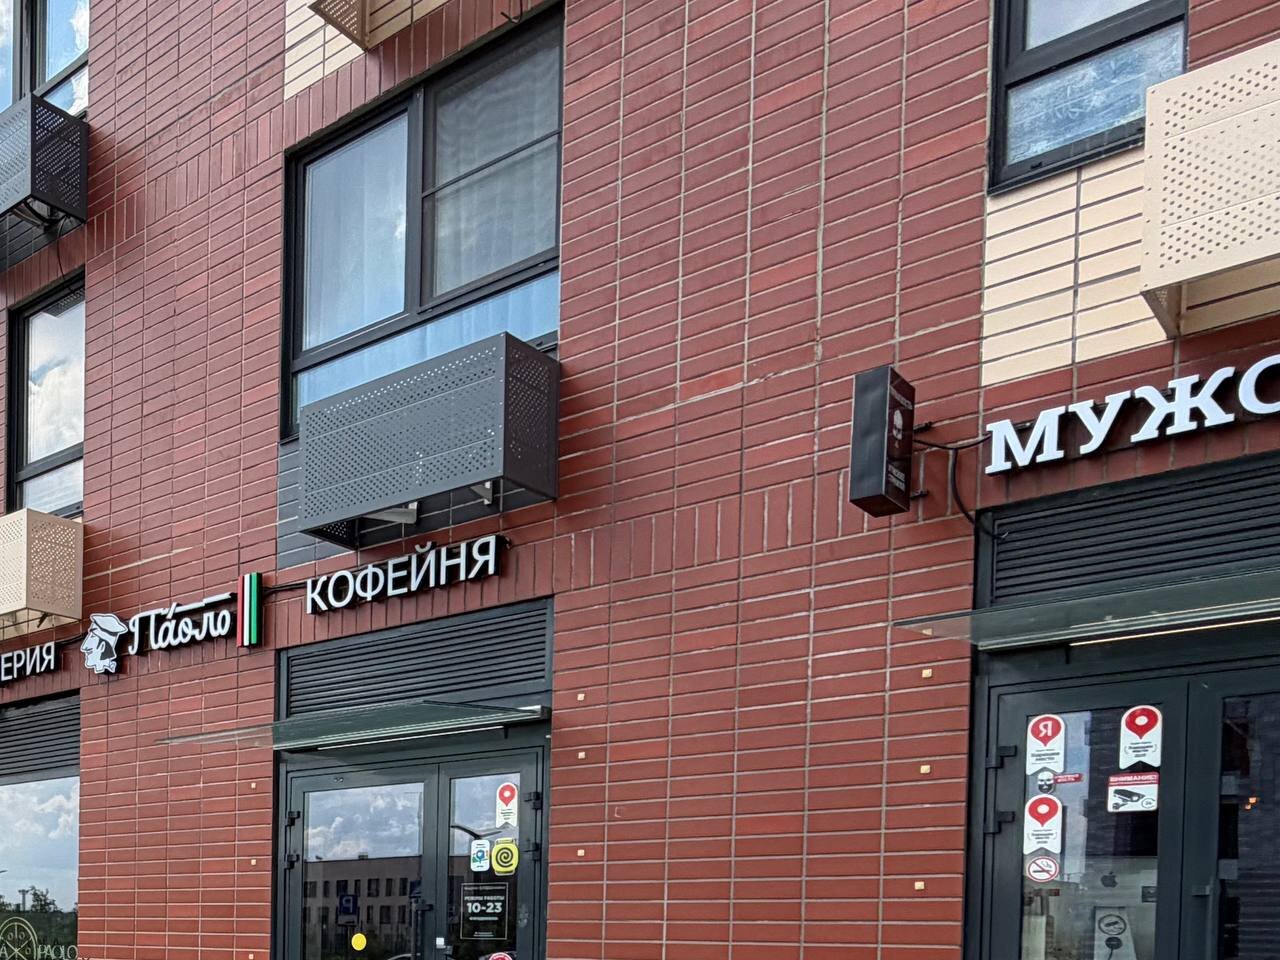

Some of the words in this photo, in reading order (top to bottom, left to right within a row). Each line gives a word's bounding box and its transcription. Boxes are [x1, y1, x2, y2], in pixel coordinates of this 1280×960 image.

[306, 534, 497, 614] КОФЕЙНЯ
[466, 902, 502, 913] 10-23
[37, 944, 79, 960] PAOLO
